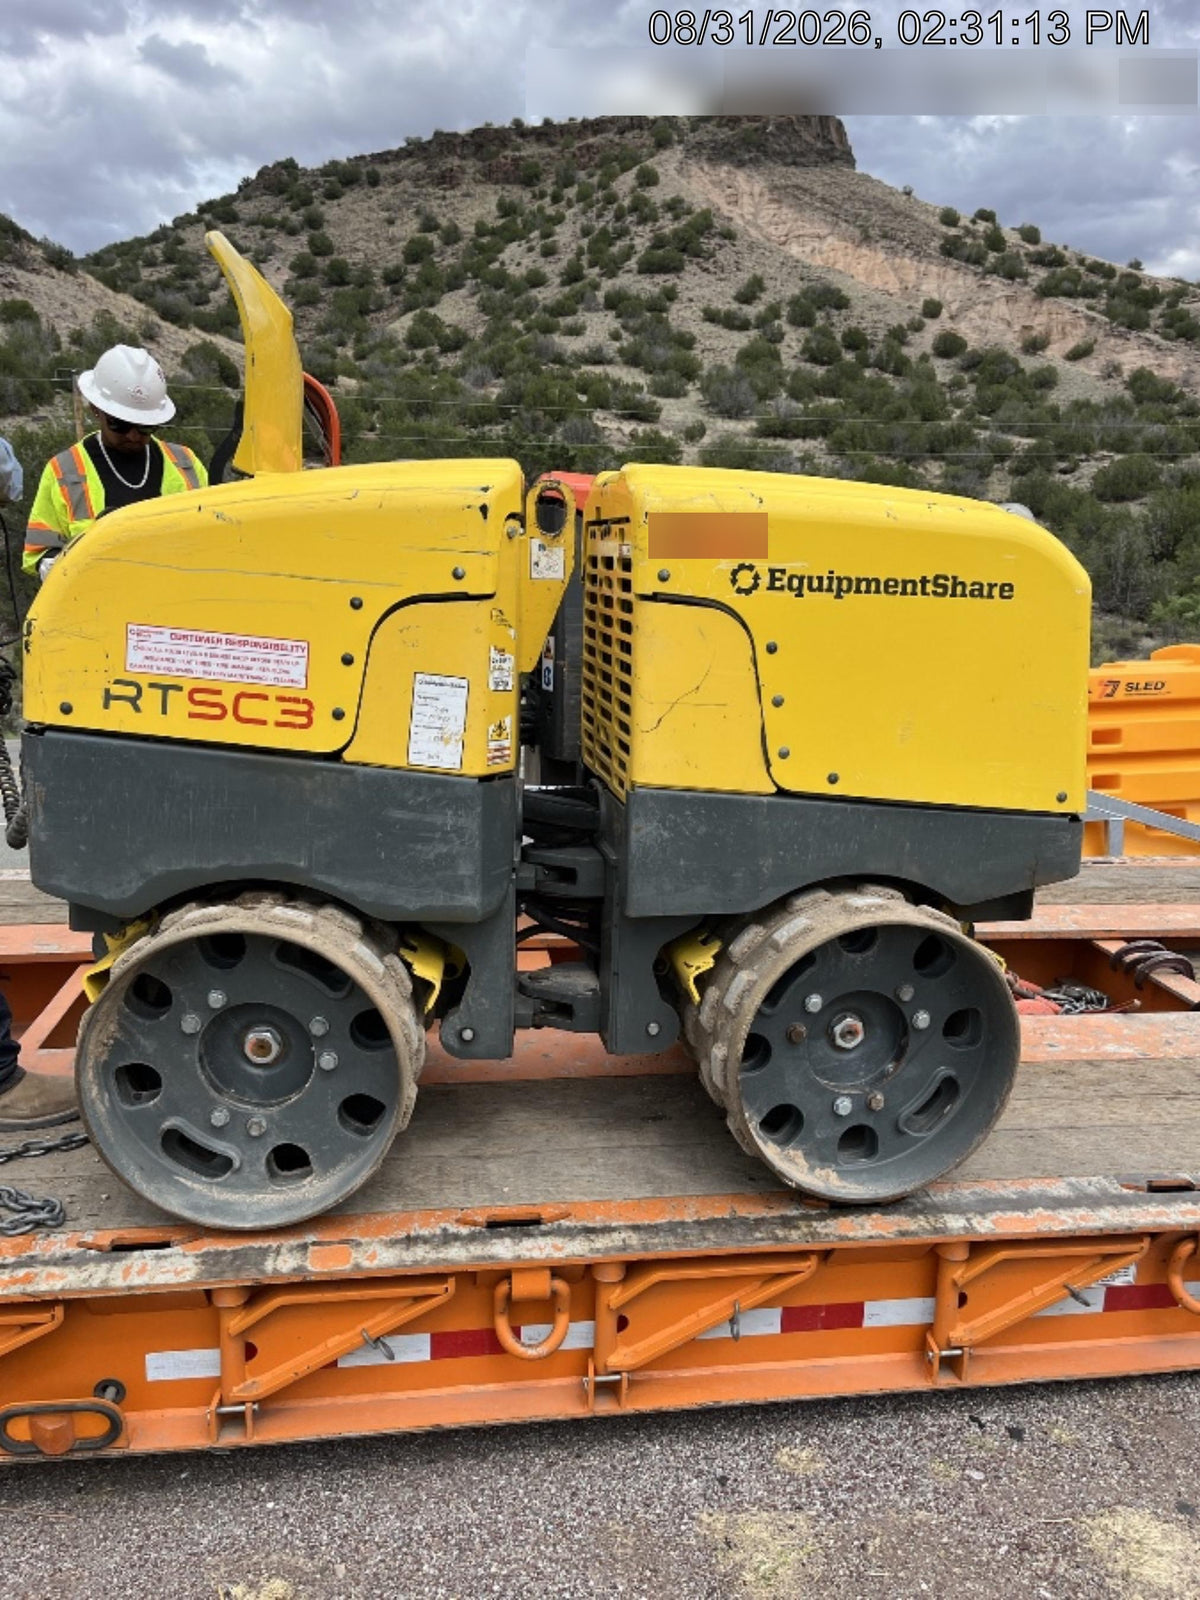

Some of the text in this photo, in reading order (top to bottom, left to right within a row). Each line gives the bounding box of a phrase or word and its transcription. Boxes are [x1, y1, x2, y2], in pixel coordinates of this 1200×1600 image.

[766, 568, 1015, 599] EquipmentShare
[170, 632, 223, 645] CUSTOMER
[225, 638, 306, 653] RESPONSIBILITY
[1125, 680, 1166, 692] SLED
